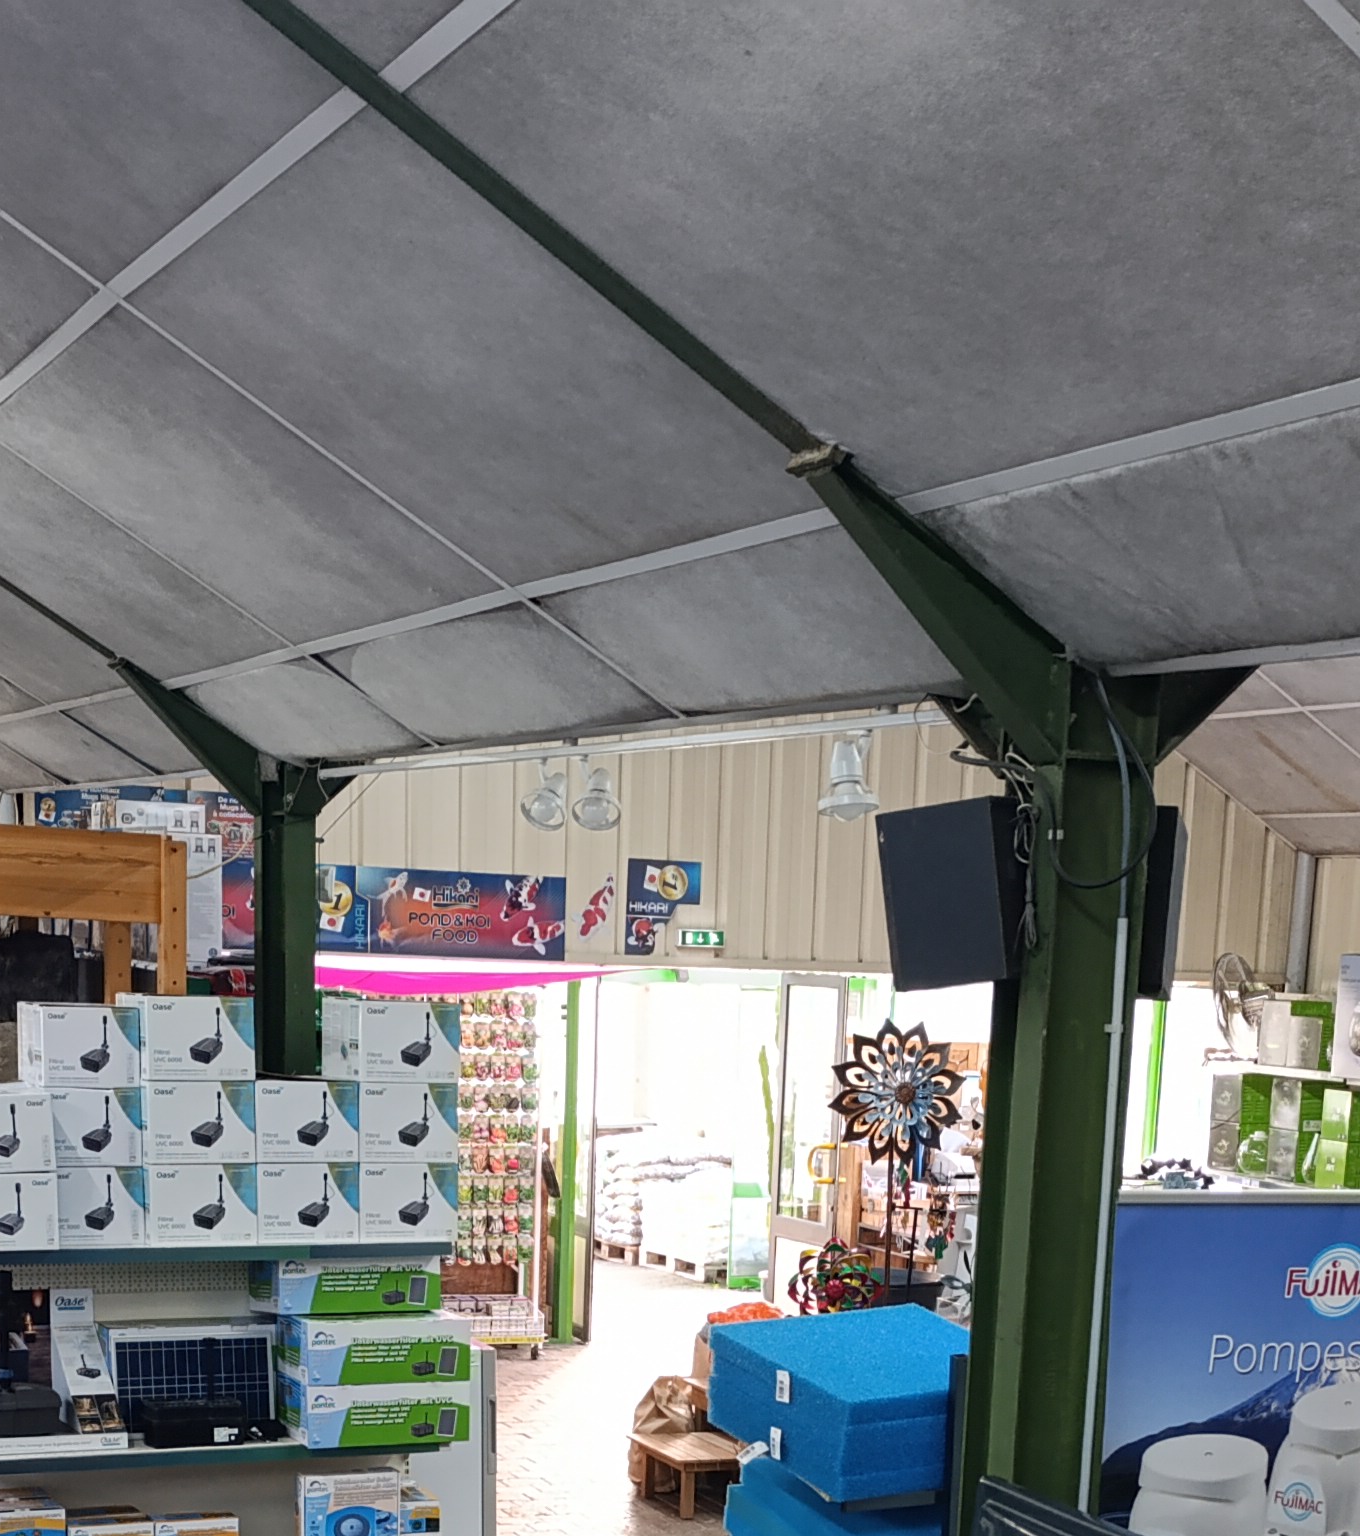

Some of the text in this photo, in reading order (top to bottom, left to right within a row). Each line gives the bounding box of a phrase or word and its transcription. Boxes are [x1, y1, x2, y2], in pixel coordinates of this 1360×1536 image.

[432, 886, 480, 905] Hikari
[629, 901, 669, 914] HIKARI
[355, 904, 366, 950] HIKARI
[432, 929, 478, 943] FOOD
[152, 1003, 173, 1011] Oase
[367, 1007, 386, 1015] Oase
[48, 1012, 65, 1020] Oase
[154, 1088, 173, 1096] Oase
[156, 1171, 176, 1179] Oase
[263, 1169, 282, 1177] Oase
[282, 1264, 423, 1275] pontec Unterwasserfilter UVC
[55, 1296, 84, 1307] Oase
[312, 1335, 454, 1347] pontec Unterwasserfilter UVC
[311, 1397, 453, 1411] pontec Unterwasserfilter UVC
